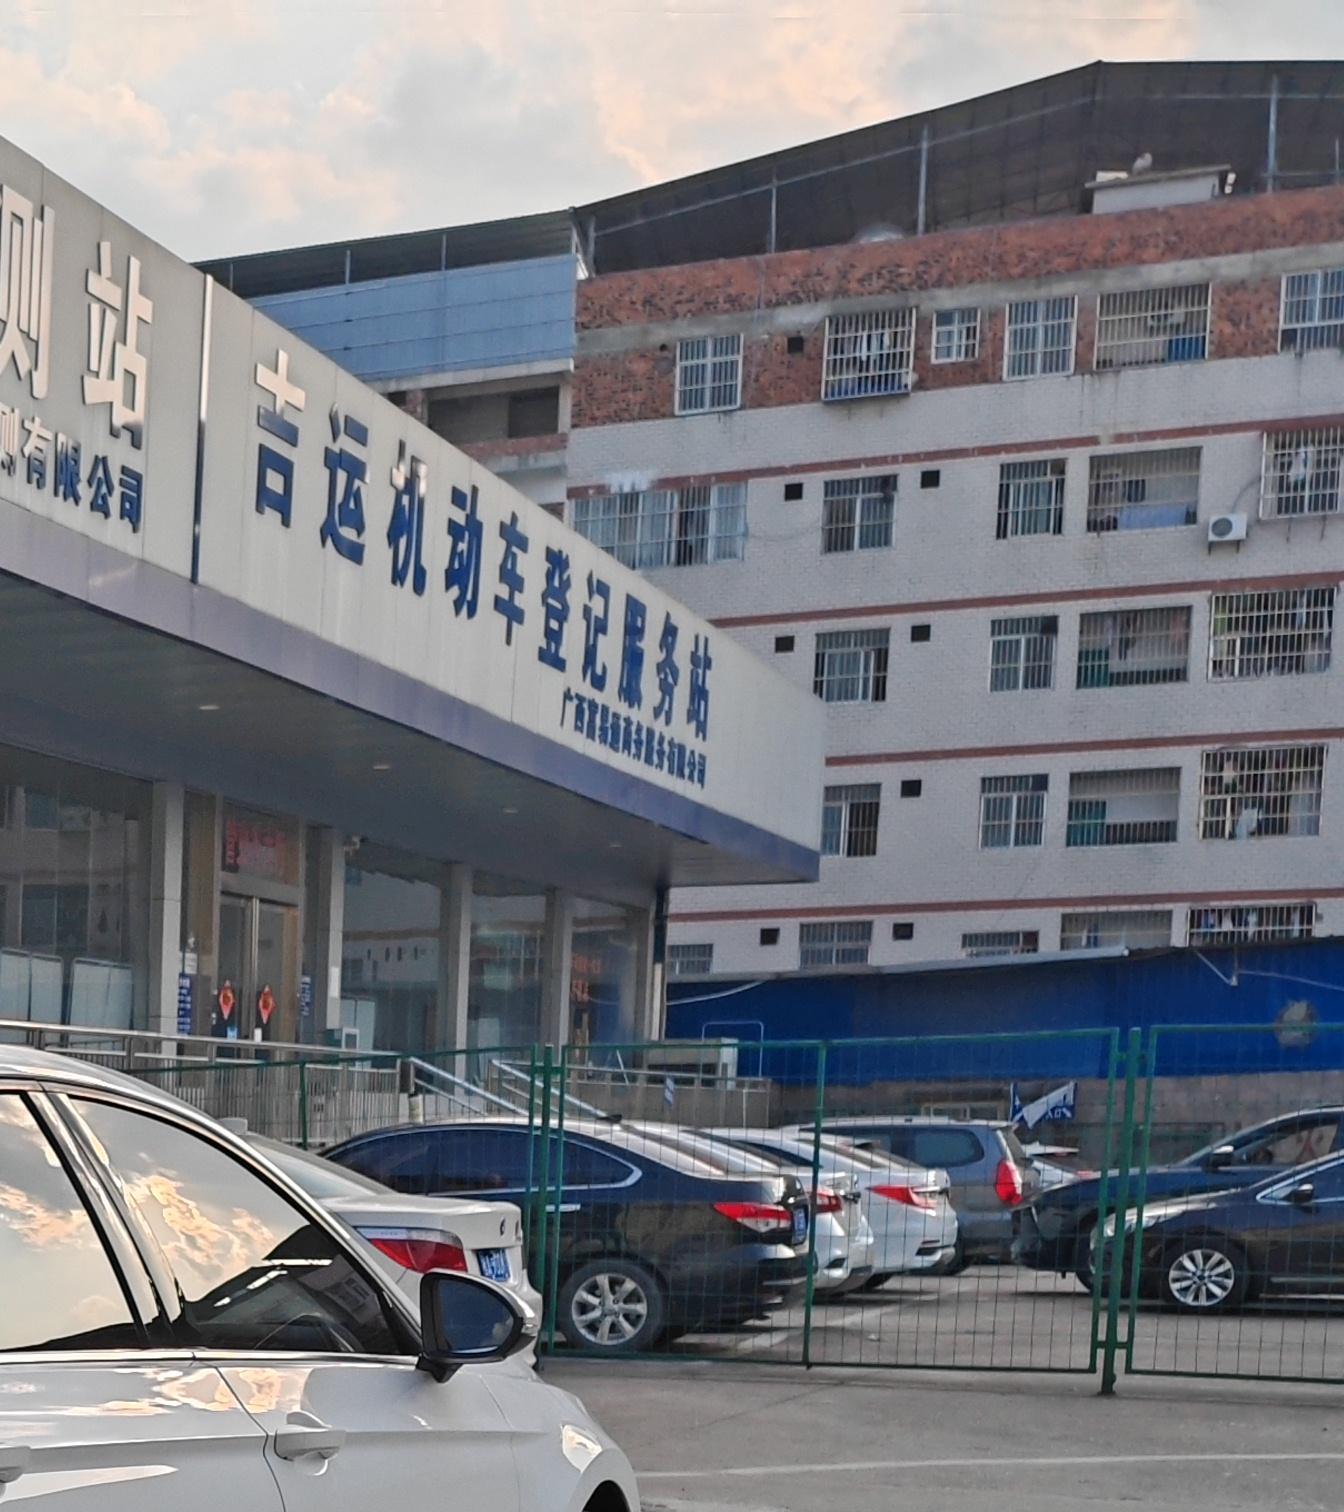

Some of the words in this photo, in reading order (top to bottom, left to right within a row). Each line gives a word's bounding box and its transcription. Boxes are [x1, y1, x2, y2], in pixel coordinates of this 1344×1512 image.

[252, 347, 712, 742] 吉运机动车登记服务站
